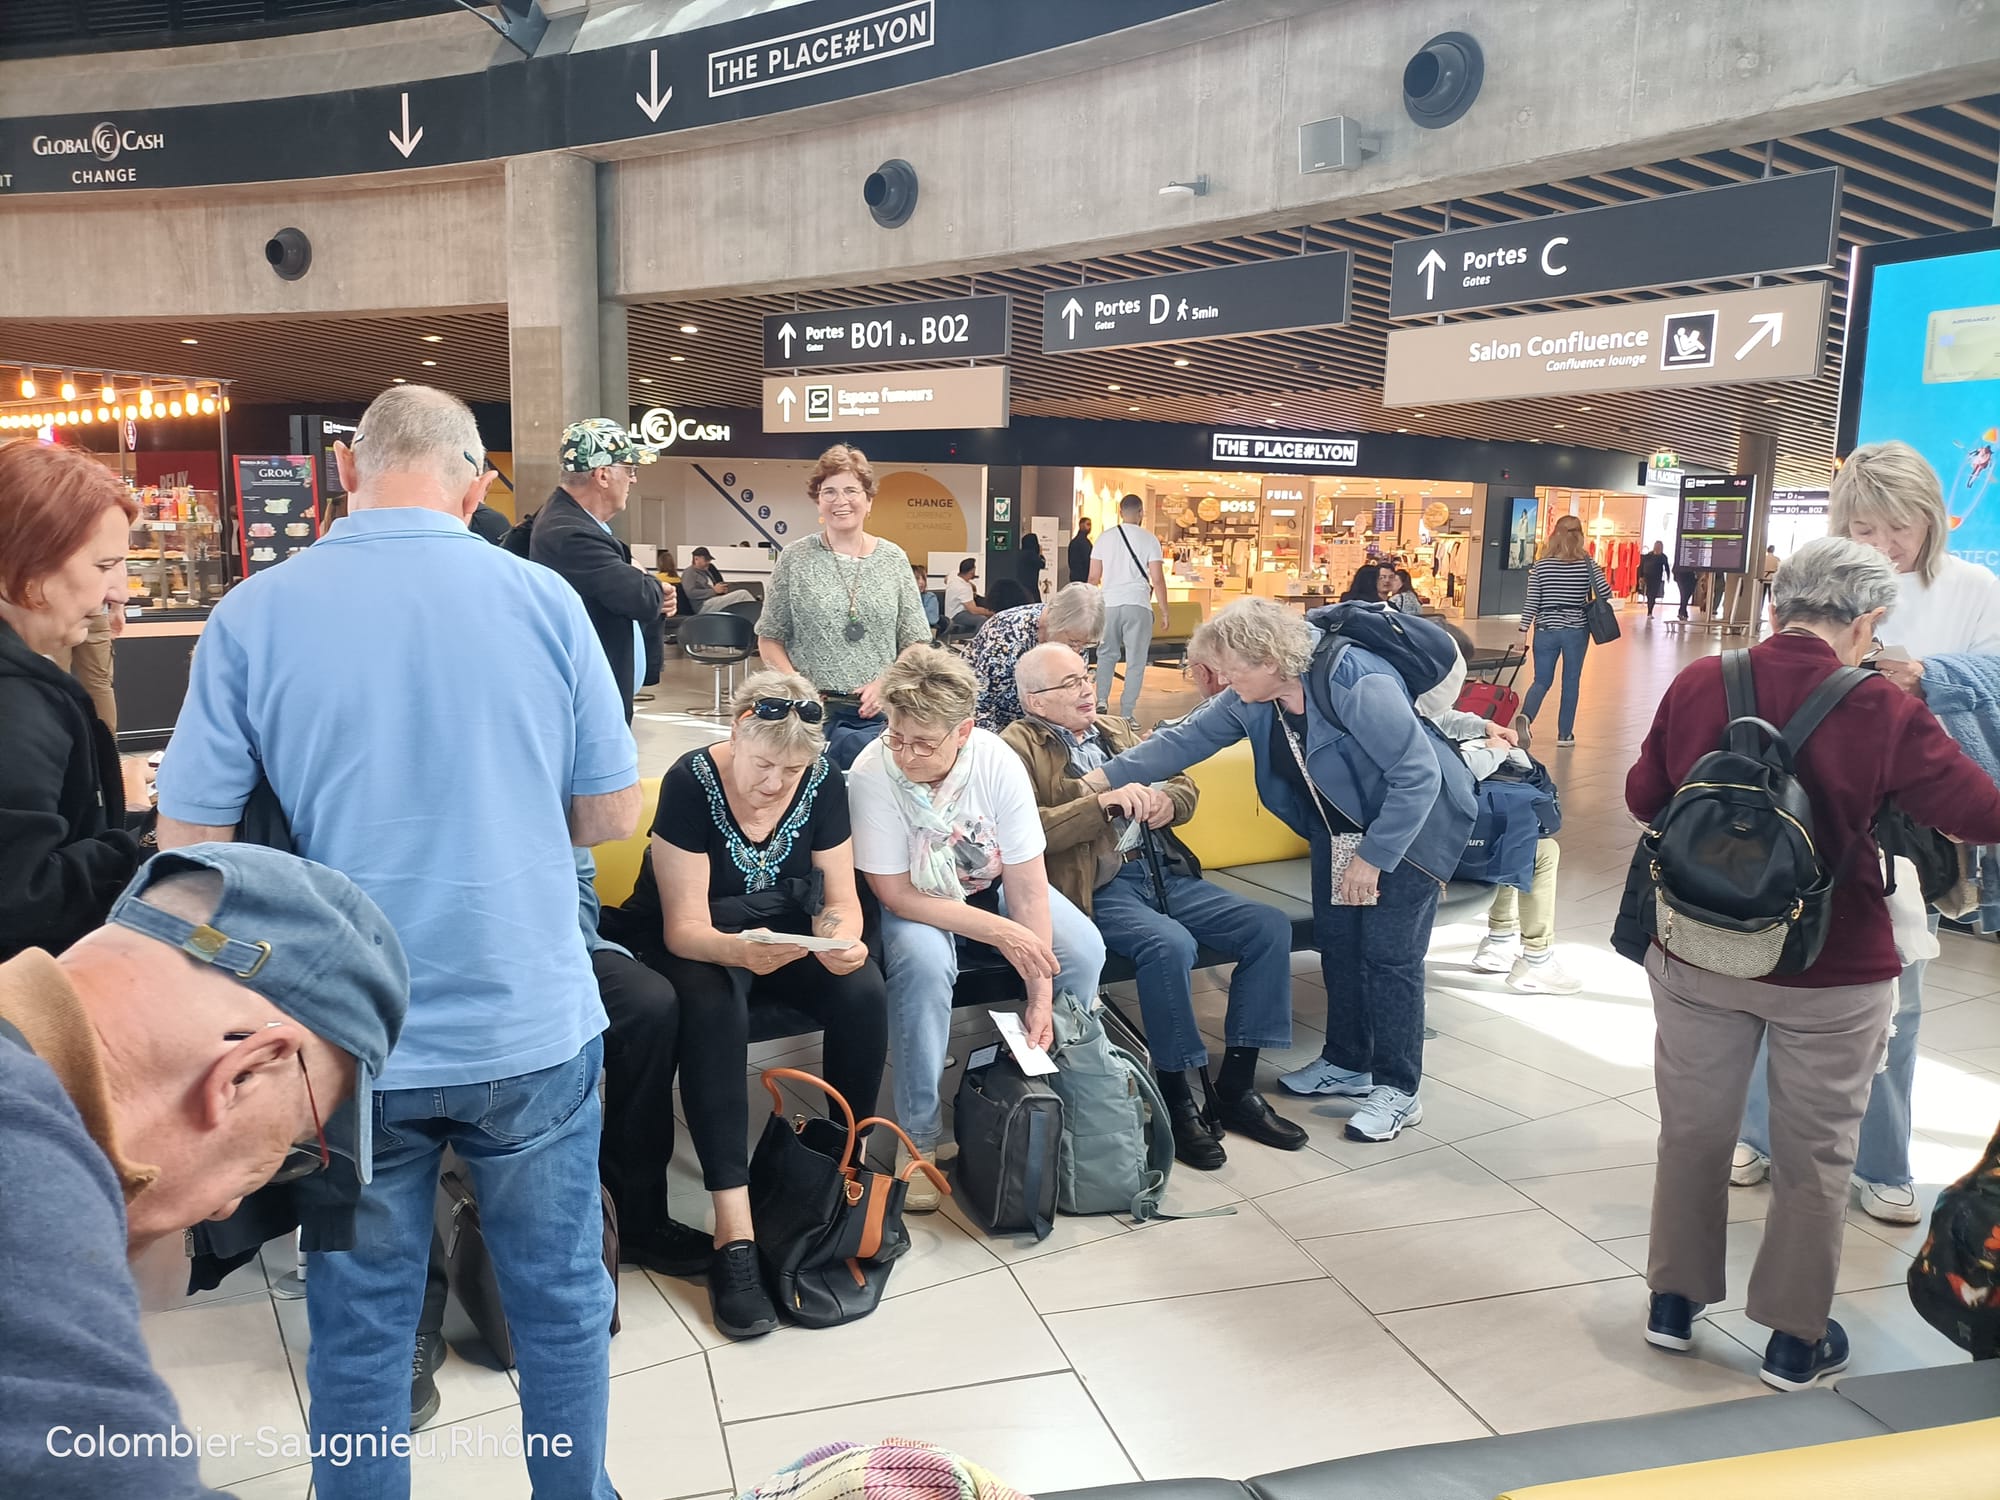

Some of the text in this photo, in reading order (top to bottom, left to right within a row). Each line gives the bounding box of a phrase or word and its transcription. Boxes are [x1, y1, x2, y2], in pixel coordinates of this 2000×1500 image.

[715, 10, 927, 85] THE PLACE#LYON
[32, 135, 92, 156] GLOBAL
[122, 130, 164, 151] CASH
[71, 168, 137, 184] CHANGE
[1462, 237, 1569, 276] Portes C
[1462, 274, 1491, 288] Gates
[1094, 294, 1219, 325] Portes D 5min
[805, 325, 845, 341] Portes
[851, 320, 893, 349] B01
[921, 314, 969, 345] B02
[1094, 320, 1115, 331] Gates
[1468, 328, 1649, 363] Salon Confluence
[1546, 353, 1647, 372] Confluence lounge
[837, 389, 879, 408] Espace
[678, 418, 731, 441] CASH
[1217, 439, 1354, 460] THE PLACE#LYON
[258, 468, 293, 478] GROM
[906, 498, 953, 508] CHANGE
[1266, 490, 1303, 500] FURLA
[1220, 500, 1256, 513] BOSS
[1950, 550, 1999, 566] TEC
